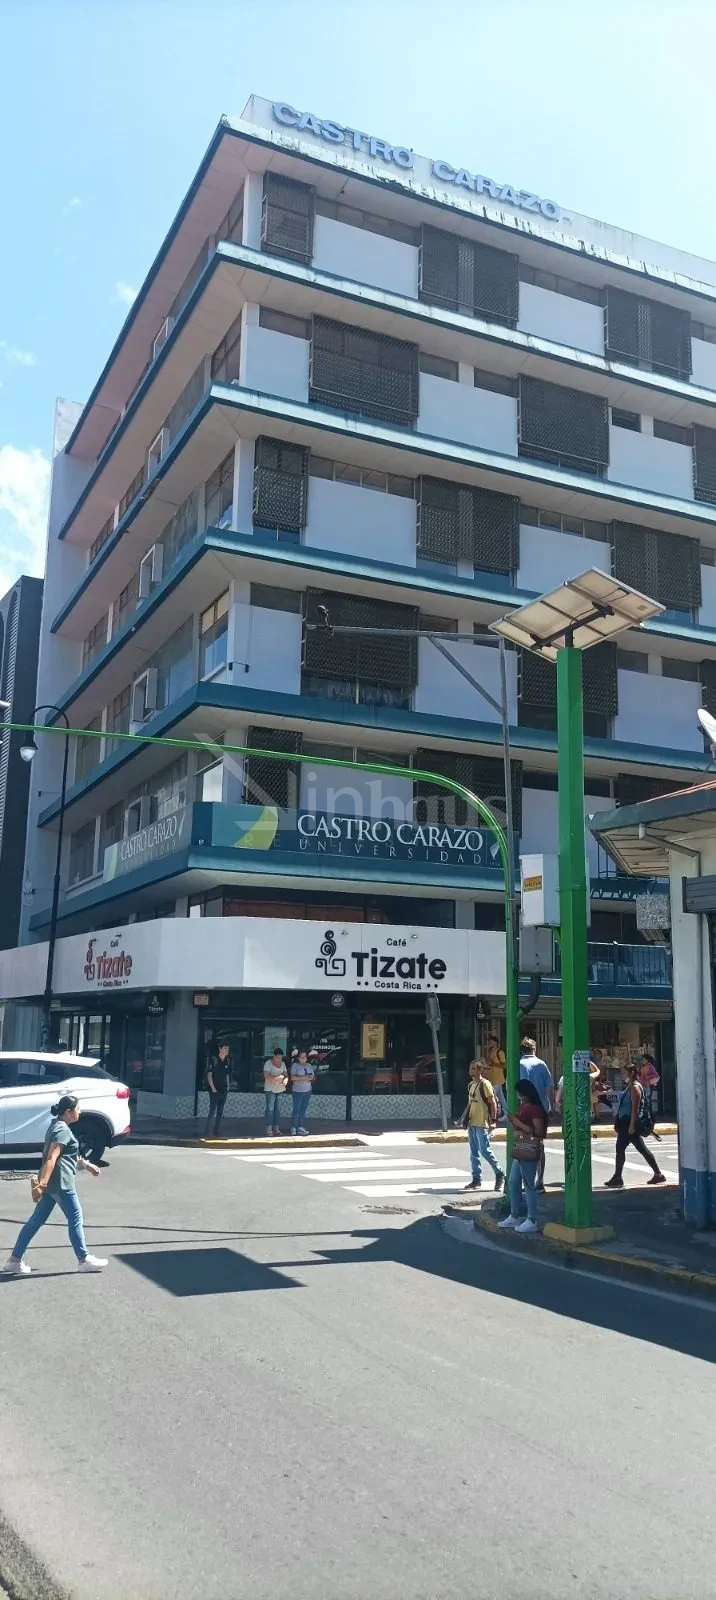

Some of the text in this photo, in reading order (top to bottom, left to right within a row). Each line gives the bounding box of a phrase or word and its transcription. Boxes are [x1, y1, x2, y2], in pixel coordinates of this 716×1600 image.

[272, 102, 561, 221] CASTRO CARAZO
[120, 815, 177, 860] CASTRO CARAZO
[297, 814, 392, 842] CASTRO
[396, 823, 484, 851] CARAZO
[299, 838, 482, 865] UNIVERSIDAD
[386, 938, 407, 947] Café
[96, 951, 132, 979] Tizate
[351, 948, 446, 979] Tizate
[374, 980, 422, 990] Costa Rica
